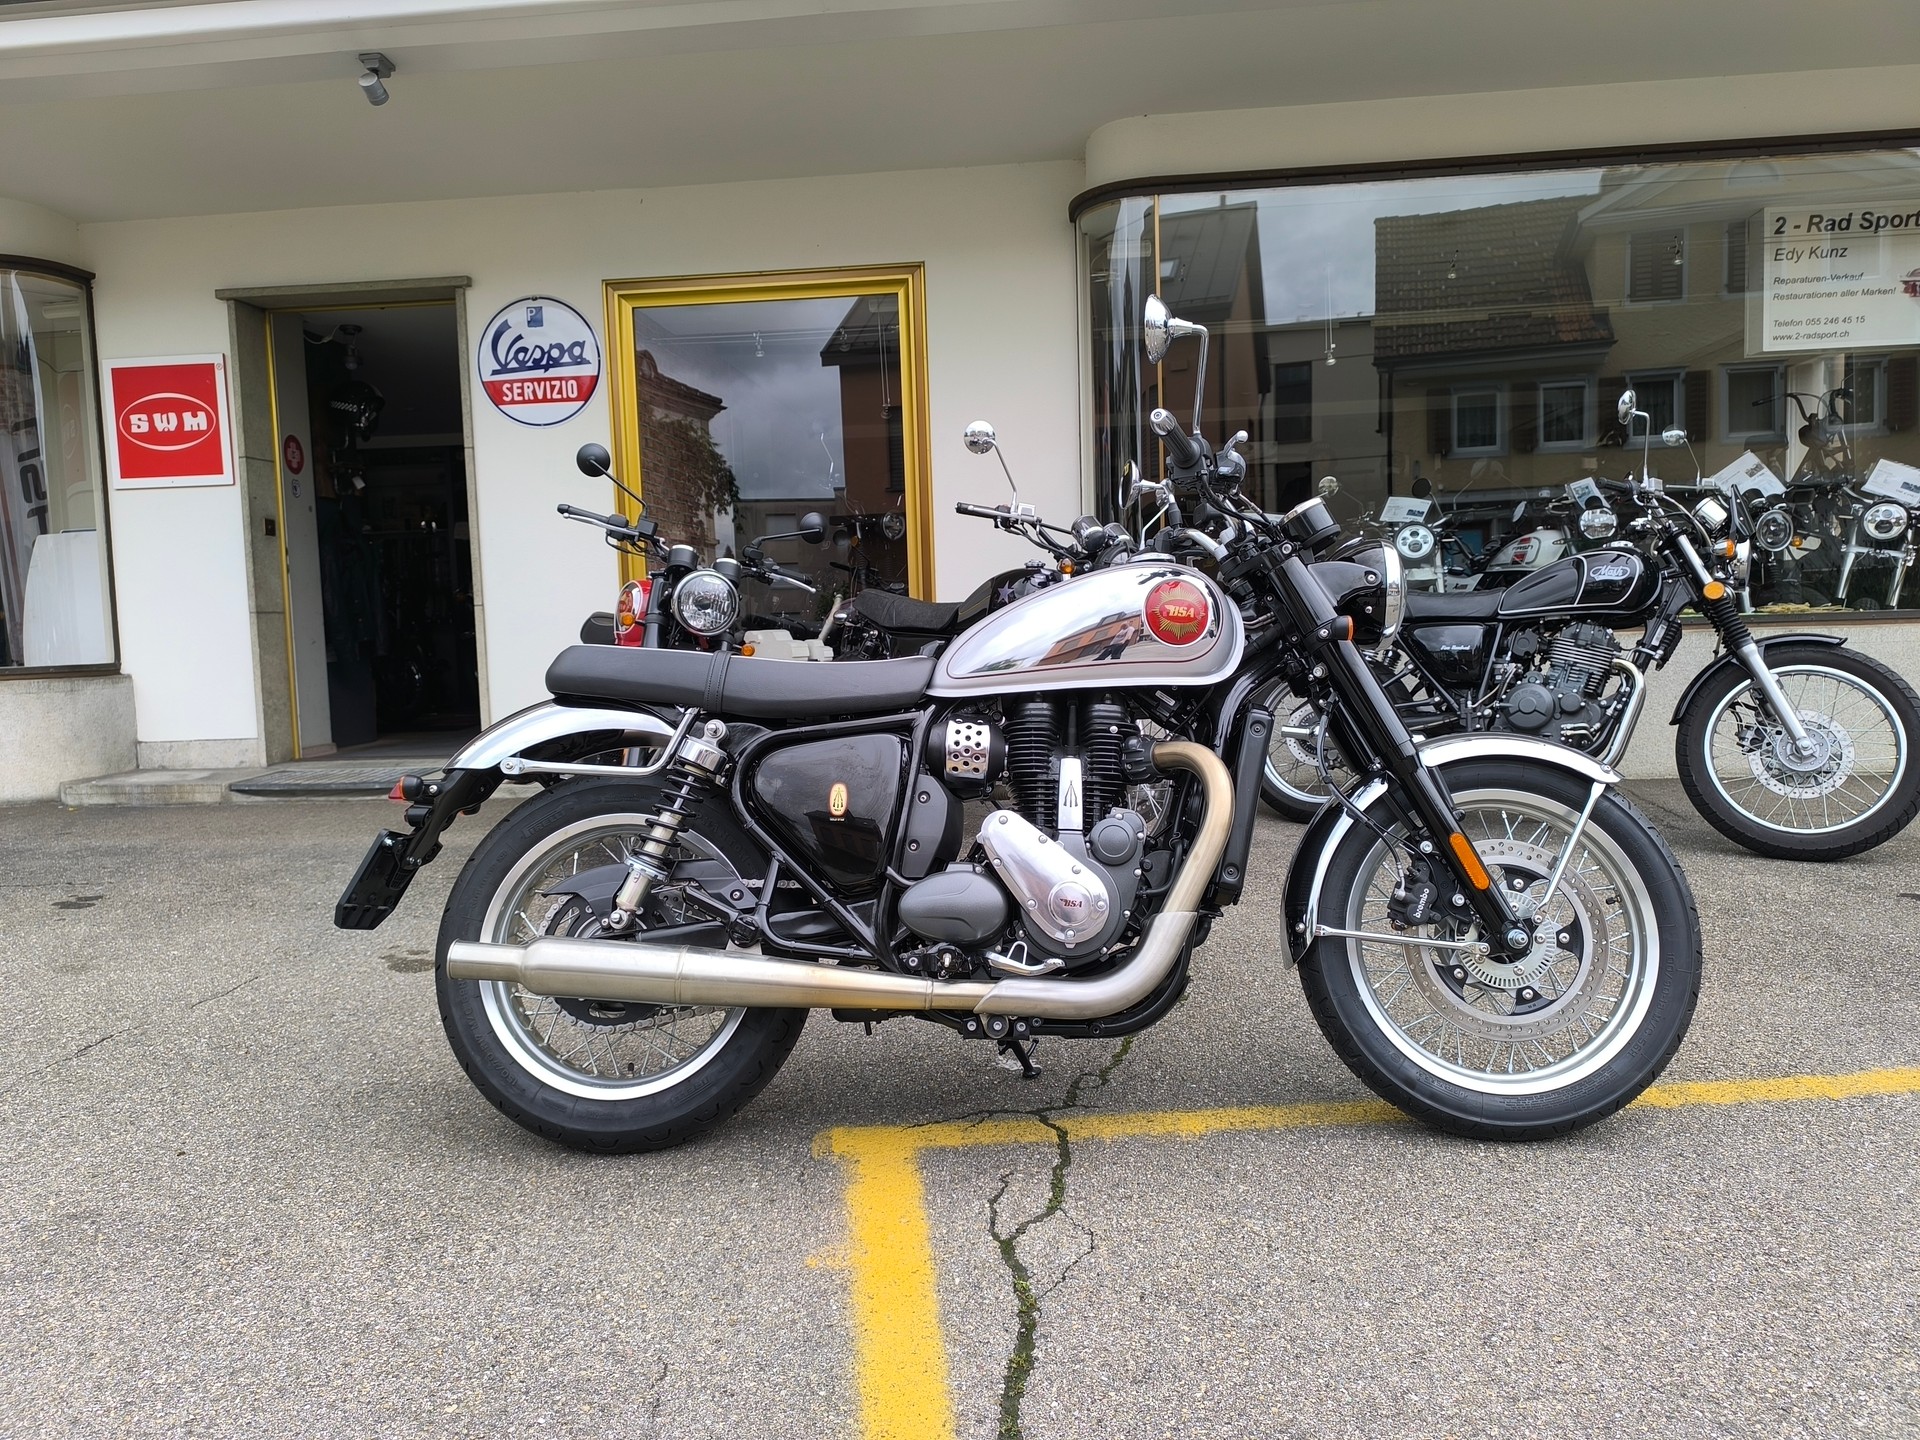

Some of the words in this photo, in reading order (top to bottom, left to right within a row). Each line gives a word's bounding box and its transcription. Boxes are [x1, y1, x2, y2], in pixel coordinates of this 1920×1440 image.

[1774, 216, 1787, 235] 2
[1806, 212, 1853, 233] Rad
[1859, 210, 1920, 234] Sport
[1774, 247, 1804, 264] Edy
[1808, 246, 1849, 260] Kunz
[1773, 272, 1865, 286] Reparaturen-Verkauf
[1773, 290, 1838, 301] Restaurationen
[1840, 289, 1859, 298] aller
[1861, 287, 1897, 297] Marken!
[1773, 317, 1803, 328] Telefon
[1805, 318, 1822, 326] 055
[1824, 316, 1839, 325] 246
[1842, 316, 1853, 325] 45
[1856, 315, 1866, 324] 15
[1773, 330, 1850, 341] www.2-radsport.ch
[490, 319, 590, 374] Vespa
[502, 380, 578, 401] SERVIZIO
[129, 411, 208, 433] SWM
[1164, 604, 1196, 618] BSA
[1060, 899, 1083, 908] BSA
[1413, 888, 1430, 918] brembo
